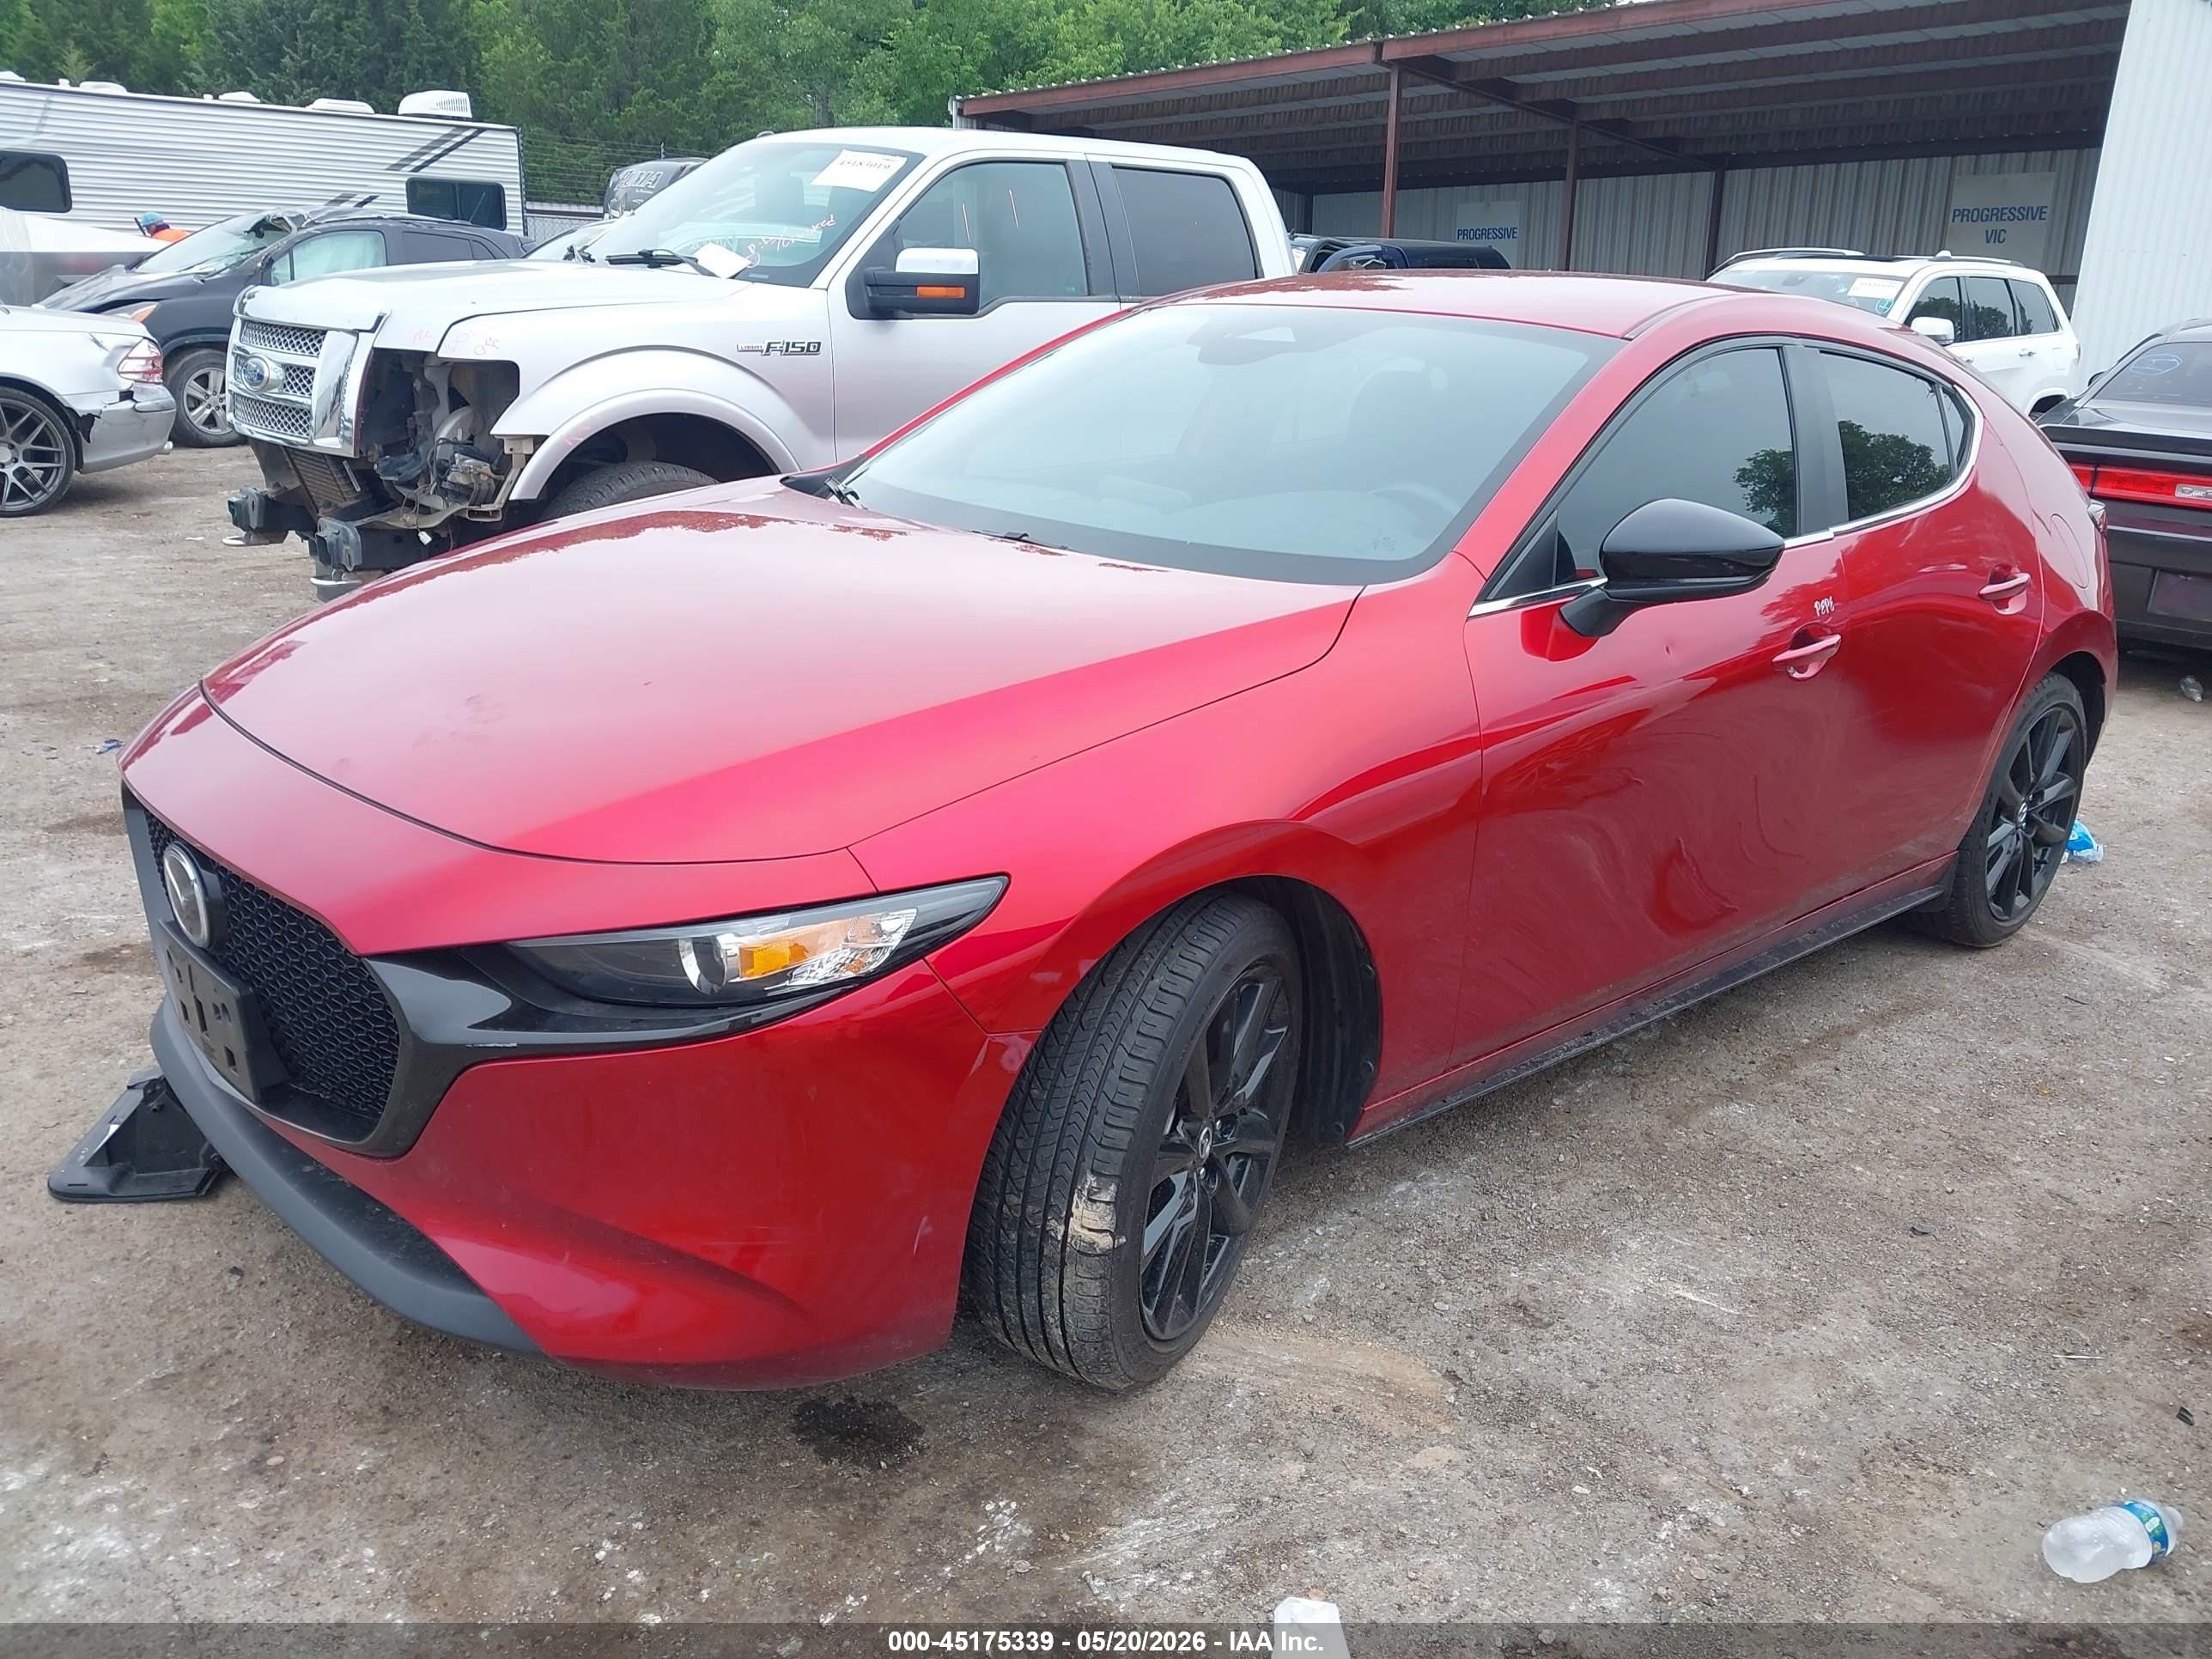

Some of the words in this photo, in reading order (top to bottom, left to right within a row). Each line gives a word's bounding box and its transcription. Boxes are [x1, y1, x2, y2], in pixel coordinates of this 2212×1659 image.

[1952, 206, 2048, 222] PROGRESSIVE
[1457, 227, 1517, 240] PROGRESSIVE
[1985, 228, 2007, 244] VIC
[765, 341, 822, 354] F-150
